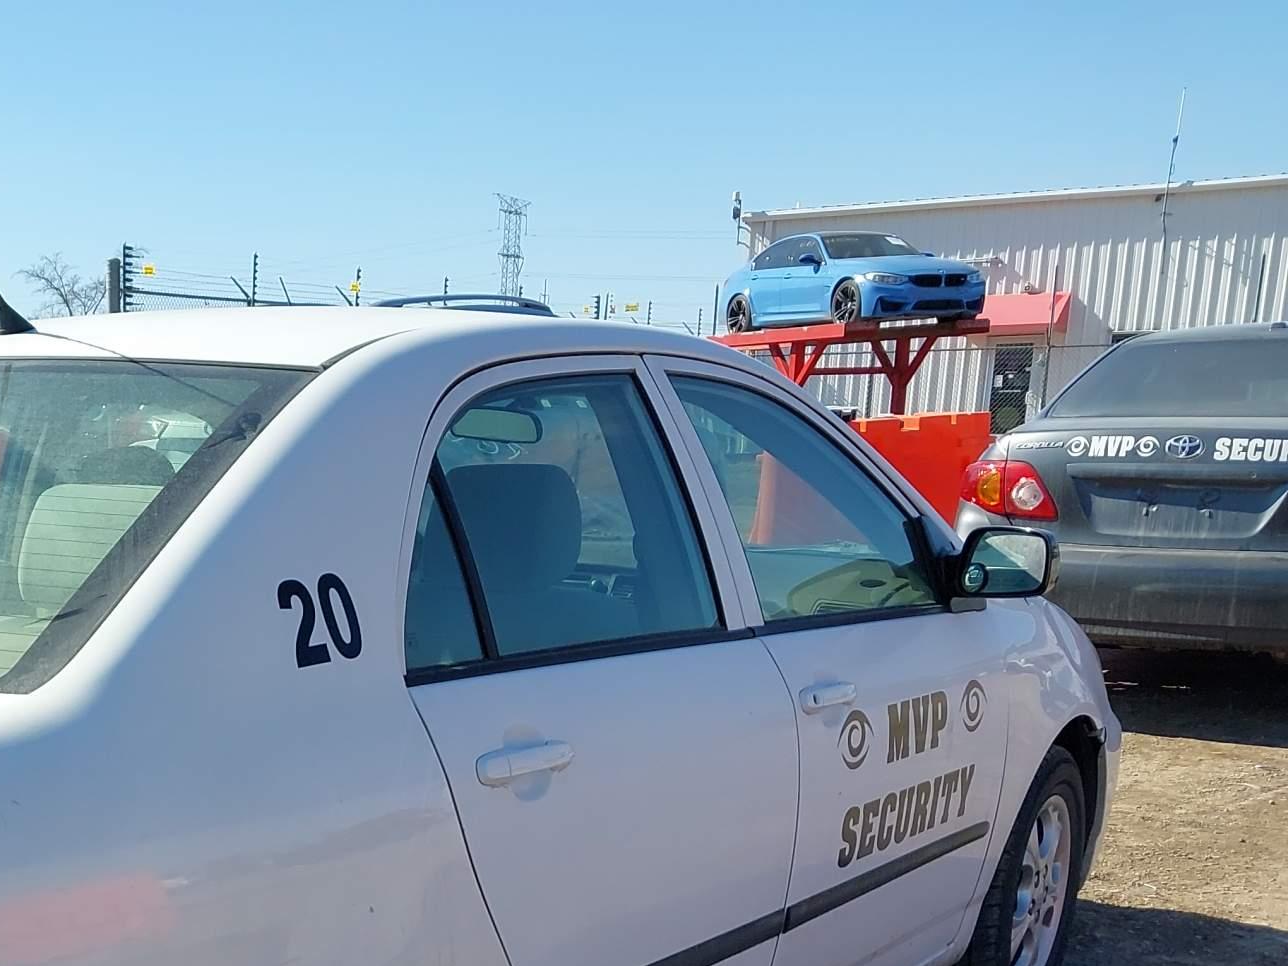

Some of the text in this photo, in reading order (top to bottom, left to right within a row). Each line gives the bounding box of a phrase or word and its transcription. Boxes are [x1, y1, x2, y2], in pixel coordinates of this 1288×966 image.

[1088, 435, 1135, 458] MVP
[277, 573, 362, 668] 20
[887, 691, 948, 764] MVP
[838, 764, 976, 868] SECURITY
